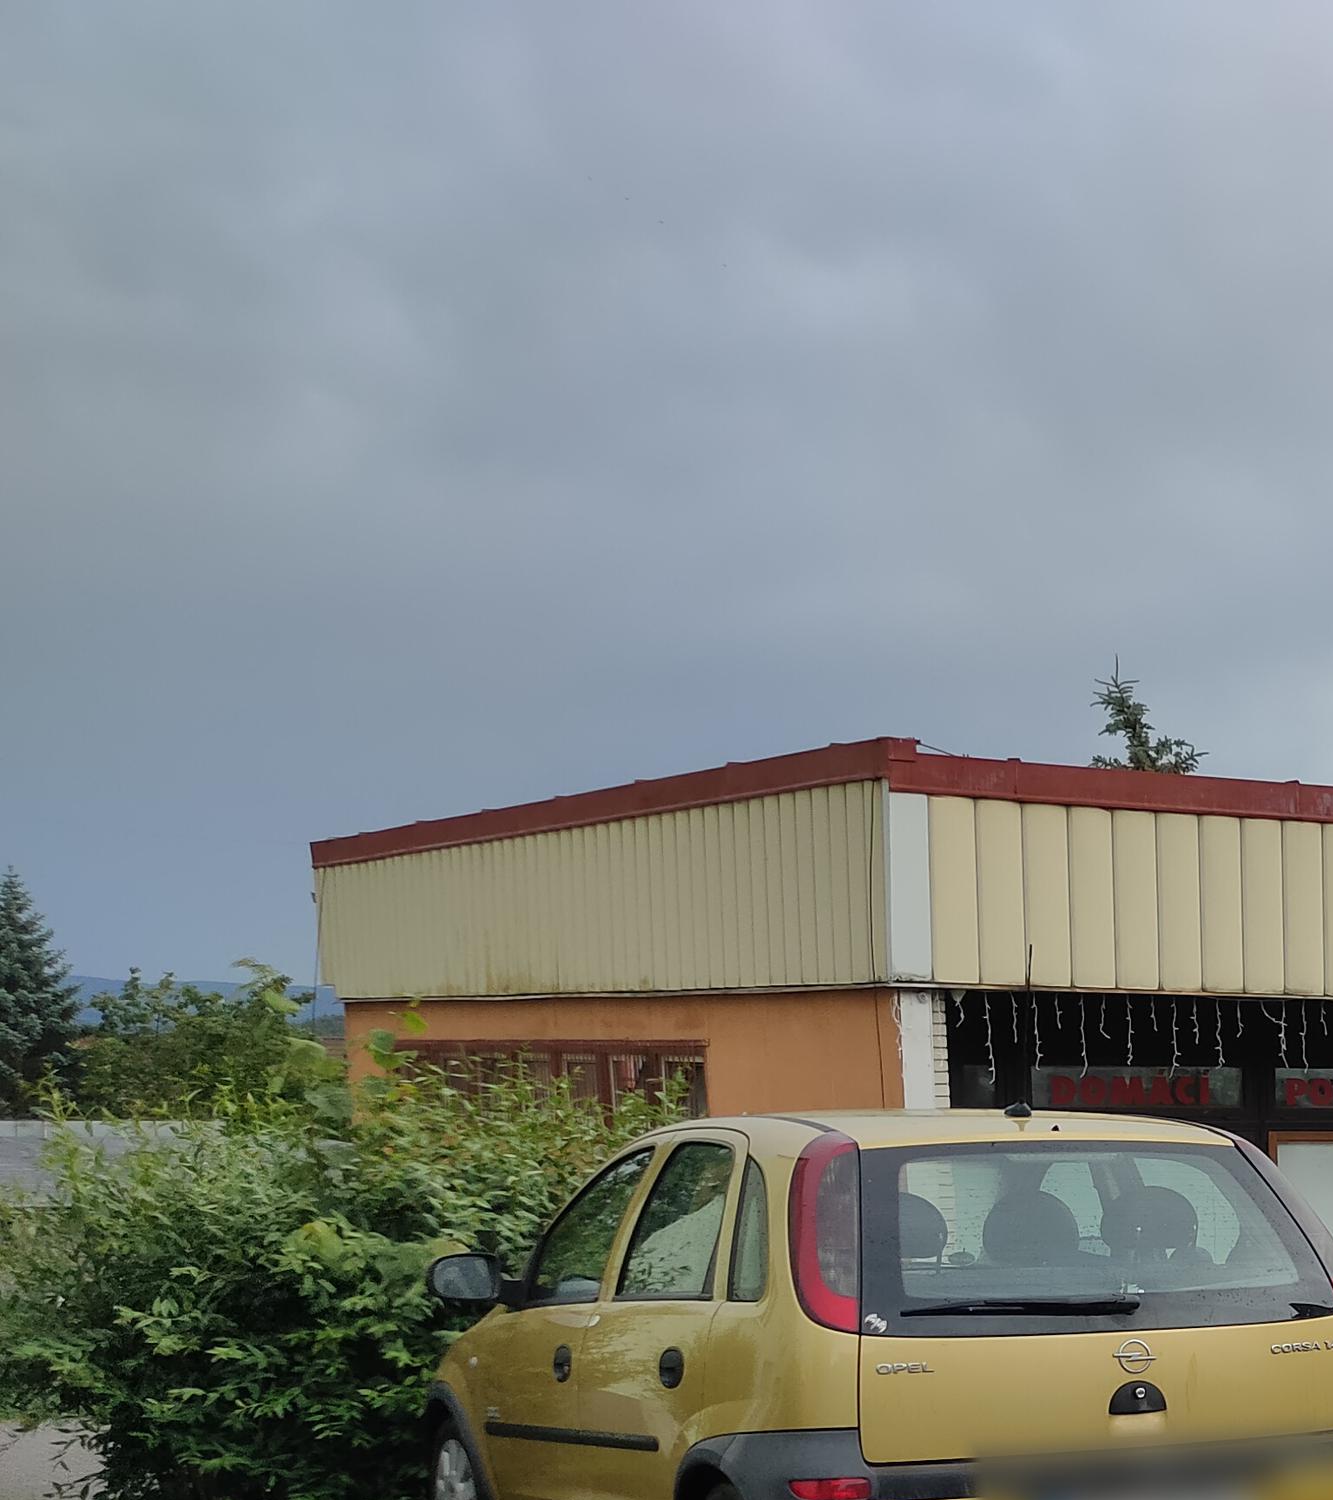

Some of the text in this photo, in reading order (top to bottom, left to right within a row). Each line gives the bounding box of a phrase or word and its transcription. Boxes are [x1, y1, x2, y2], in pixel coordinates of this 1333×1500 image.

[1052, 1068, 1210, 1105] DOMÁCÍ
[1271, 1341, 1321, 1355] CORSA
[876, 1361, 935, 1375] OPEL
